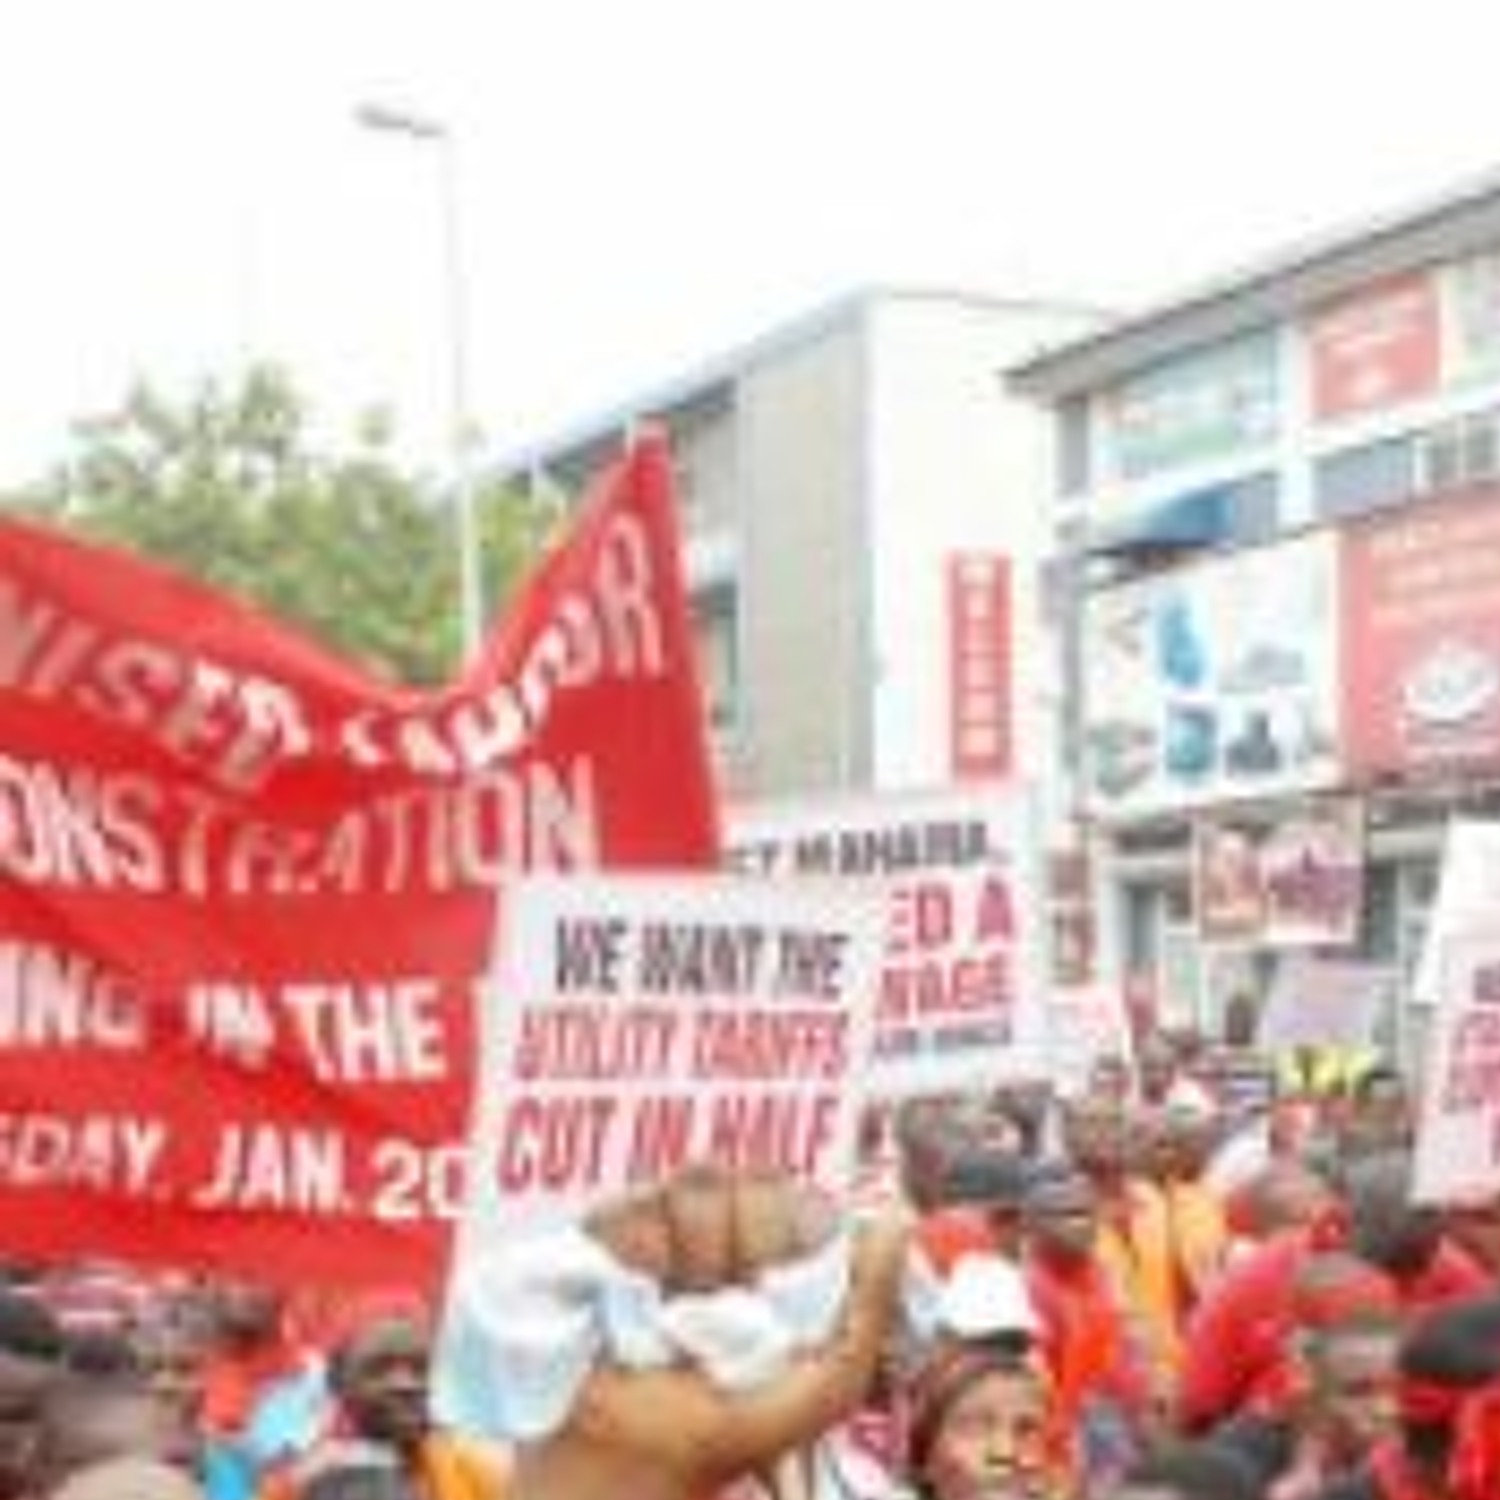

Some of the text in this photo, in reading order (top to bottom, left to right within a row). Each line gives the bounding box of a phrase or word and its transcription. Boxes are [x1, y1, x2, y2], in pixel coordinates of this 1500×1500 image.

[974, 872, 1016, 944] A
[554, 914, 850, 1000] WE WANT THE
[184, 978, 276, 1072] IN
[280, 976, 448, 1084] THE
[512, 1002, 680, 1082] UTILITY
[688, 1008, 850, 1082] TARIFFS
[497, 1096, 618, 1192] CUT
[626, 1096, 696, 1188] IN
[710, 1096, 842, 1180] HALF
